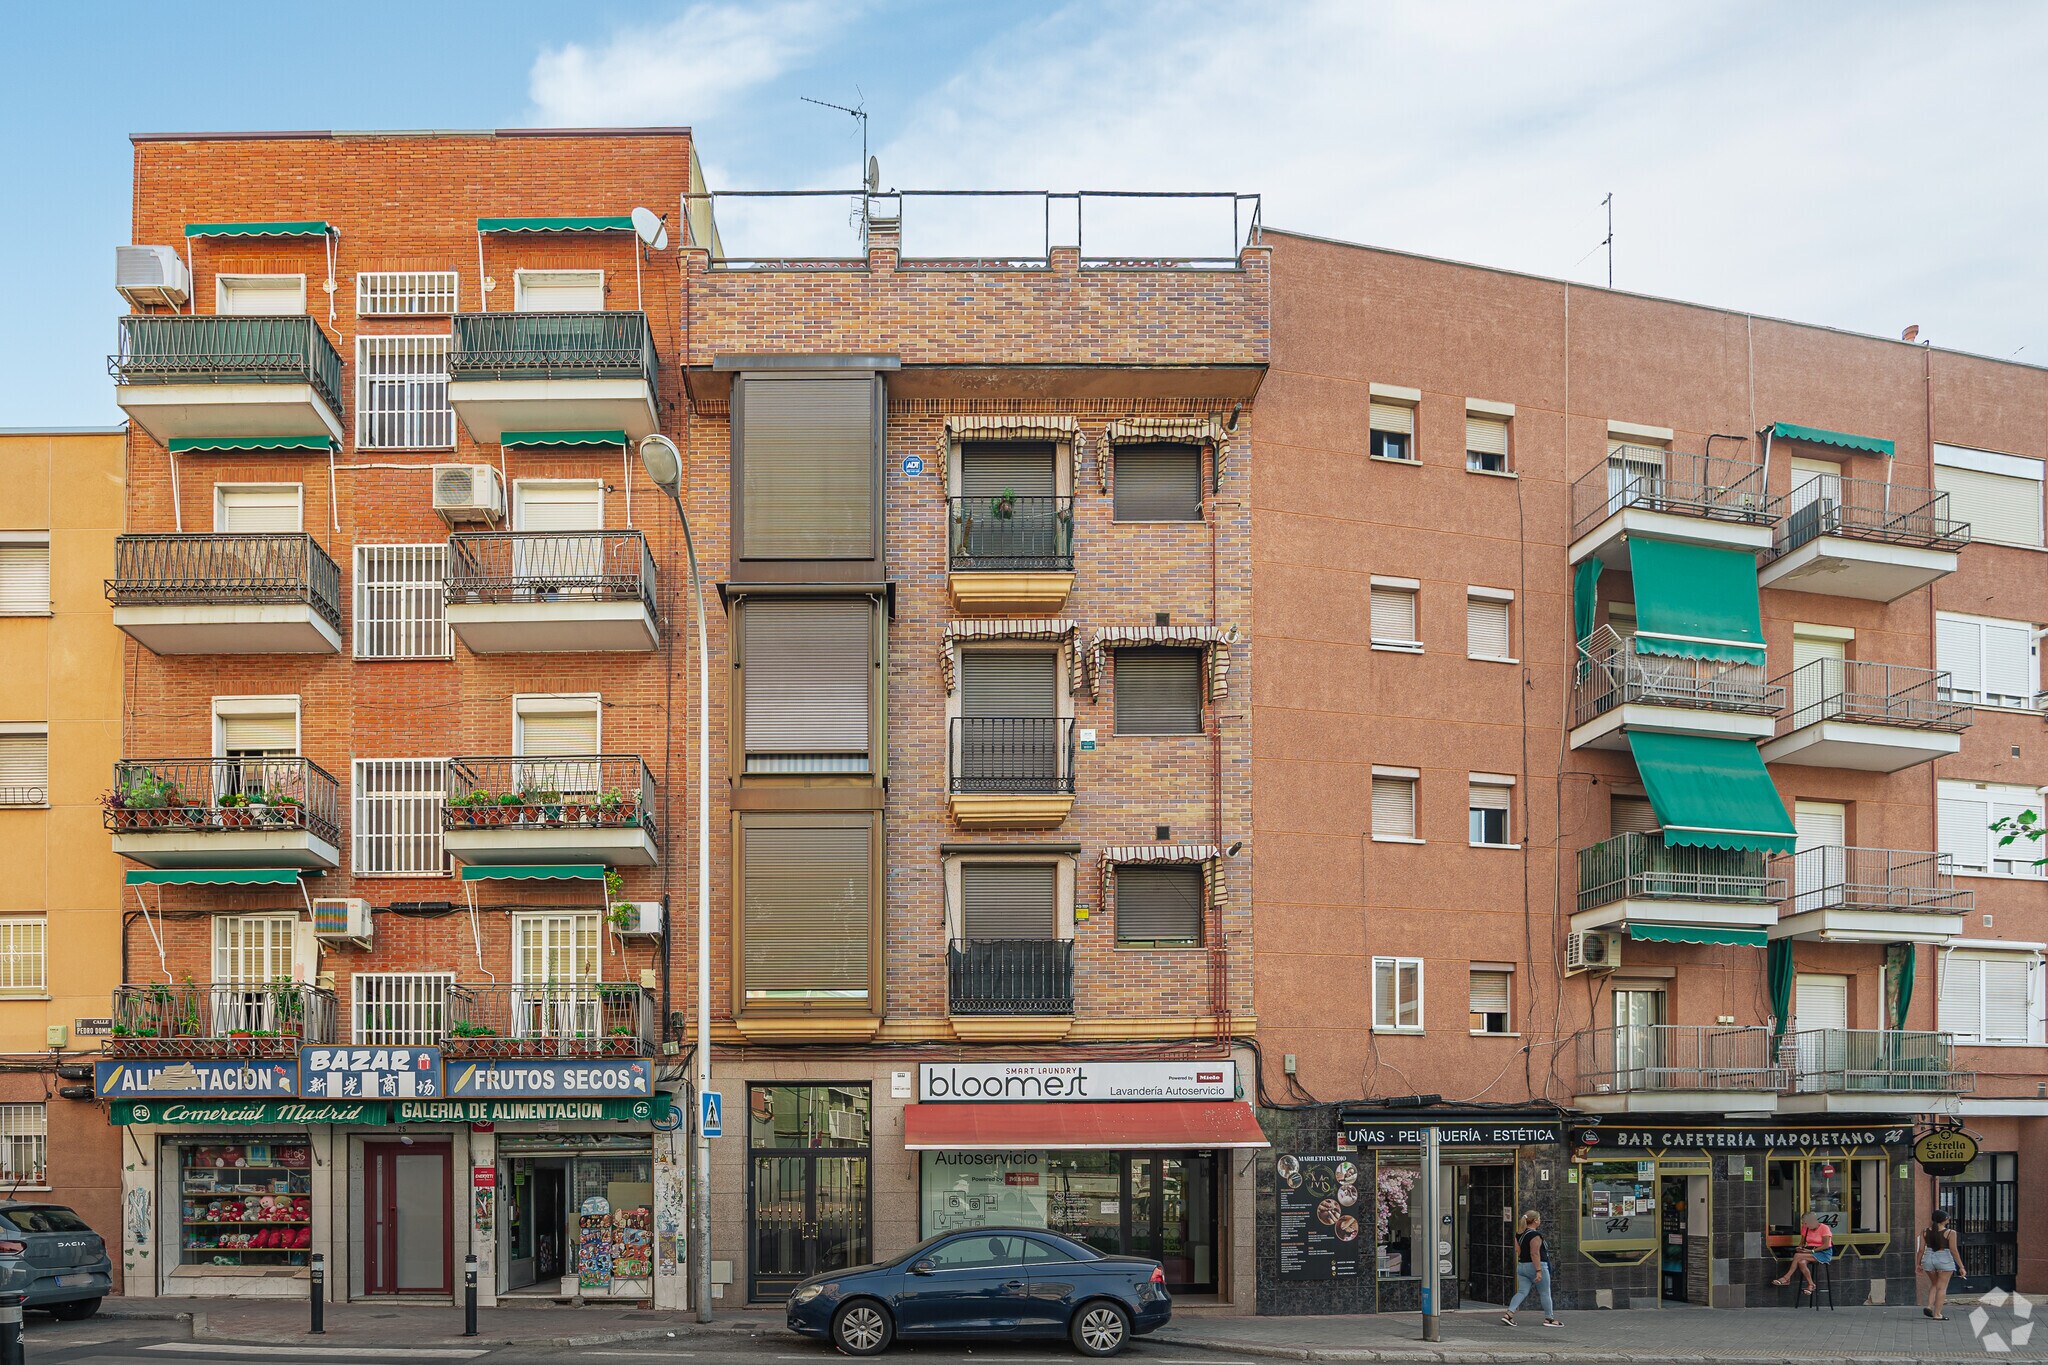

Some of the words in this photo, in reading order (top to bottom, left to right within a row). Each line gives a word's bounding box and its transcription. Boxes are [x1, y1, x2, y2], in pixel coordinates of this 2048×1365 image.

[76, 1027, 94, 1035] PEDRO
[310, 1050, 411, 1072] BAZAR
[1005, 1067, 1035, 1075] SMART
[475, 1069, 556, 1090] FRUTOS
[563, 1069, 630, 1090] SECOS
[929, 1067, 1088, 1097] bloomest
[1110, 1086, 1163, 1096] Lavandería
[1165, 1086, 1225, 1096] Autoservicio
[135, 1108, 147, 1117] 25
[162, 1104, 266, 1121] Comercial
[276, 1104, 363, 1122] Madrid
[401, 1102, 464, 1120] GALERIA
[469, 1102, 487, 1120] DE
[492, 1102, 602, 1120] ALIMENTACION
[636, 1105, 648, 1114] 25
[398, 1125, 407, 1133] 25
[1348, 1128, 1385, 1142] UÑAS
[1493, 1128, 1555, 1141] ESTÉTICA
[1617, 1132, 1653, 1146] BAR
[1661, 1131, 1756, 1147] CAFETERÍA
[1764, 1132, 1875, 1146] NAPOLETANO
[1926, 1141, 1966, 1150] Estrella
[934, 1150, 1038, 1165] Autoservicio
[1926, 1150, 1964, 1159] Galicia
[1542, 1171, 1547, 1180] 1
